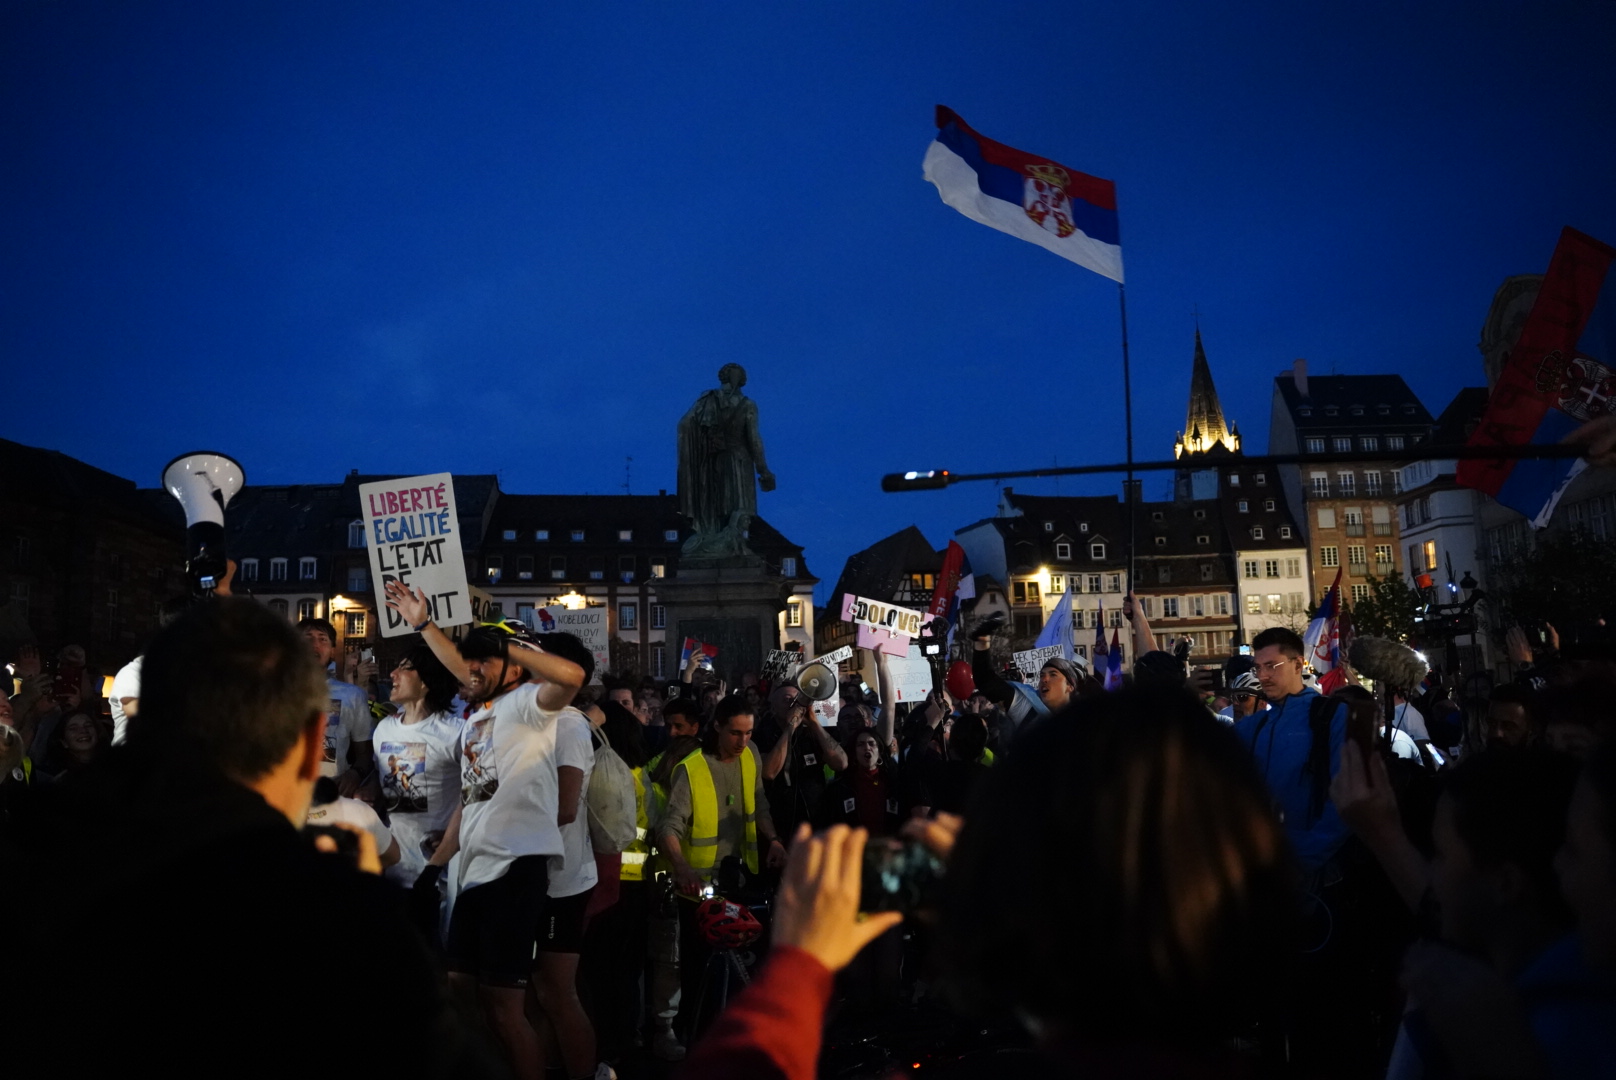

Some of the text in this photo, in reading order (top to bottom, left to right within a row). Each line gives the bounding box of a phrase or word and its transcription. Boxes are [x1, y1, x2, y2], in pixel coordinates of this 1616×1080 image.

[369, 482, 448, 517] LIBERTÉ
[373, 507, 451, 545] EGALITÉ
[377, 538, 446, 572] L'ETAT
[386, 591, 459, 630] DIT
[1015, 644, 1063, 663] НЕК БУЛЕВАРИ
